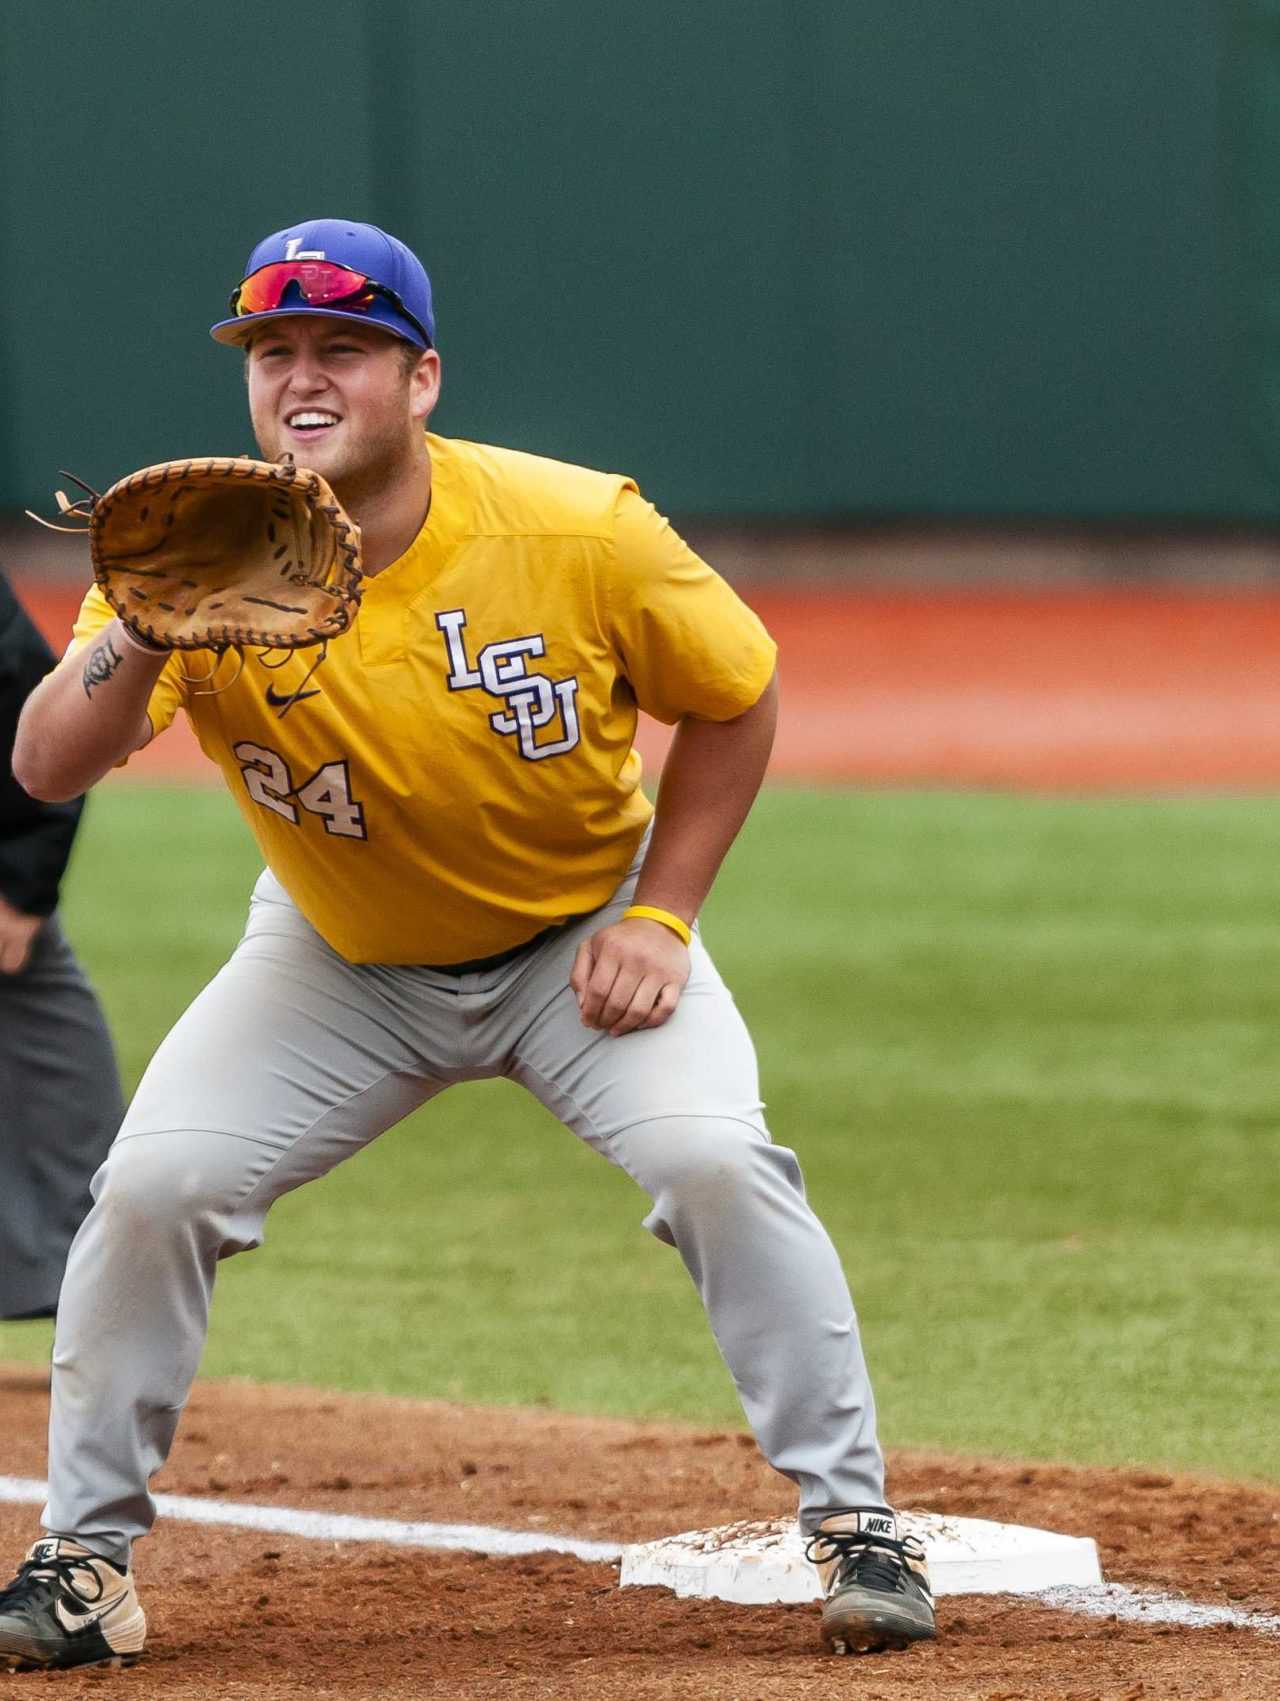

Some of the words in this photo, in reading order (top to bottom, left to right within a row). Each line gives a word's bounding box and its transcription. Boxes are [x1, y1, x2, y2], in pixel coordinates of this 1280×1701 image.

[435, 608, 580, 761] LSU
[233, 741, 368, 841] 24
[864, 1518, 893, 1534] NIKE
